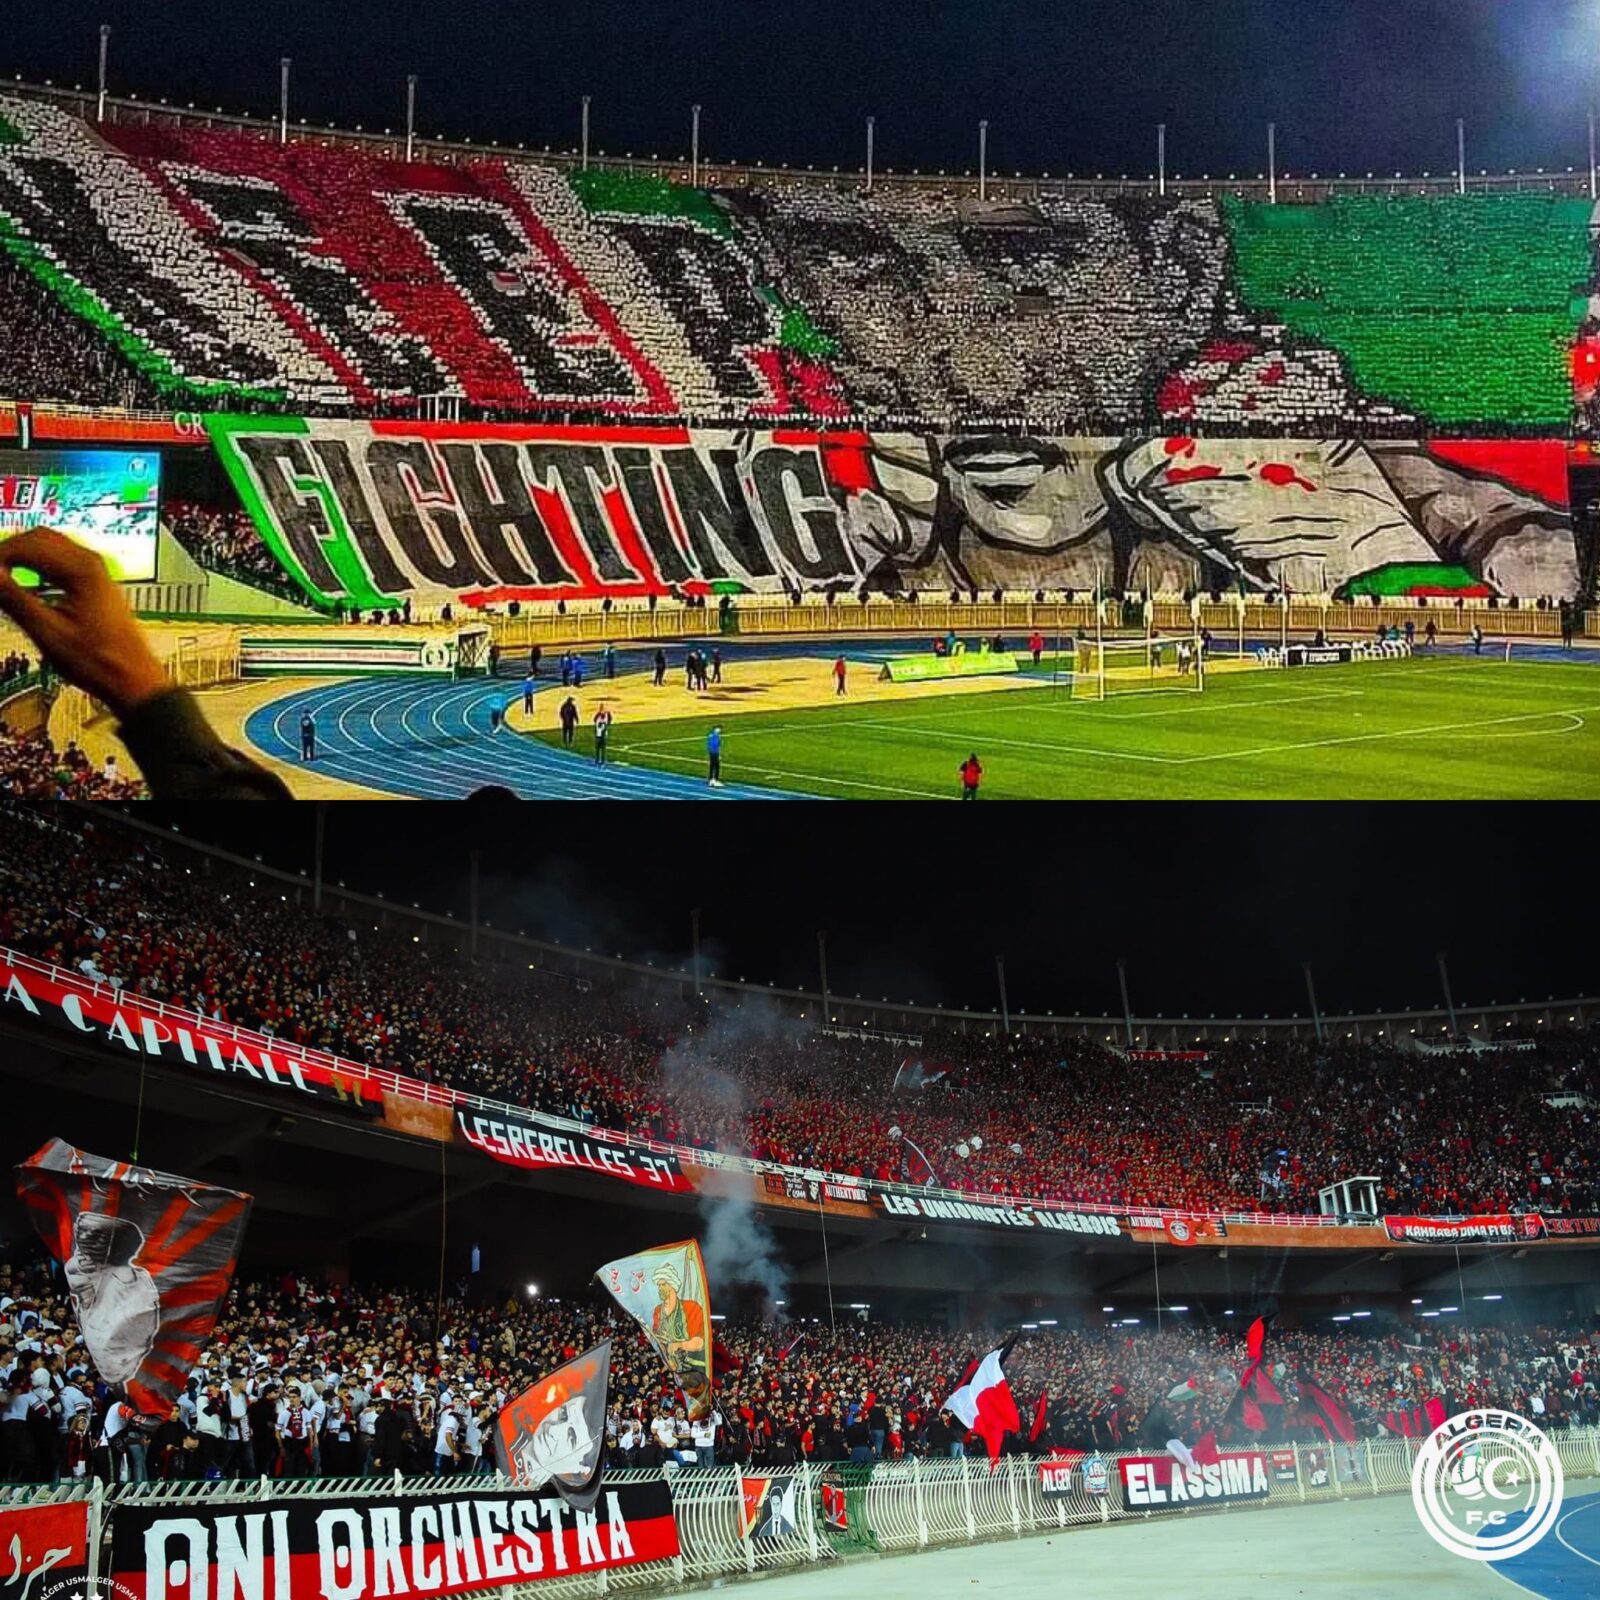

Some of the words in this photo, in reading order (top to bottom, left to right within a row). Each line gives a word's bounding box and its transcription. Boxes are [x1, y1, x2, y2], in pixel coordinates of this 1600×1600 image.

[235, 436, 860, 597] FIGHTING
[61, 992, 318, 1094] CAPITALE
[880, 1194, 920, 1216] LES
[1460, 1225, 1488, 1237] DIMA
[1042, 1468, 1072, 1492] ALGER
[1125, 1463, 1167, 1504] EL
[1171, 1457, 1268, 1502] ASSIMA
[315, 1491, 635, 1598] ORCHESTRA
